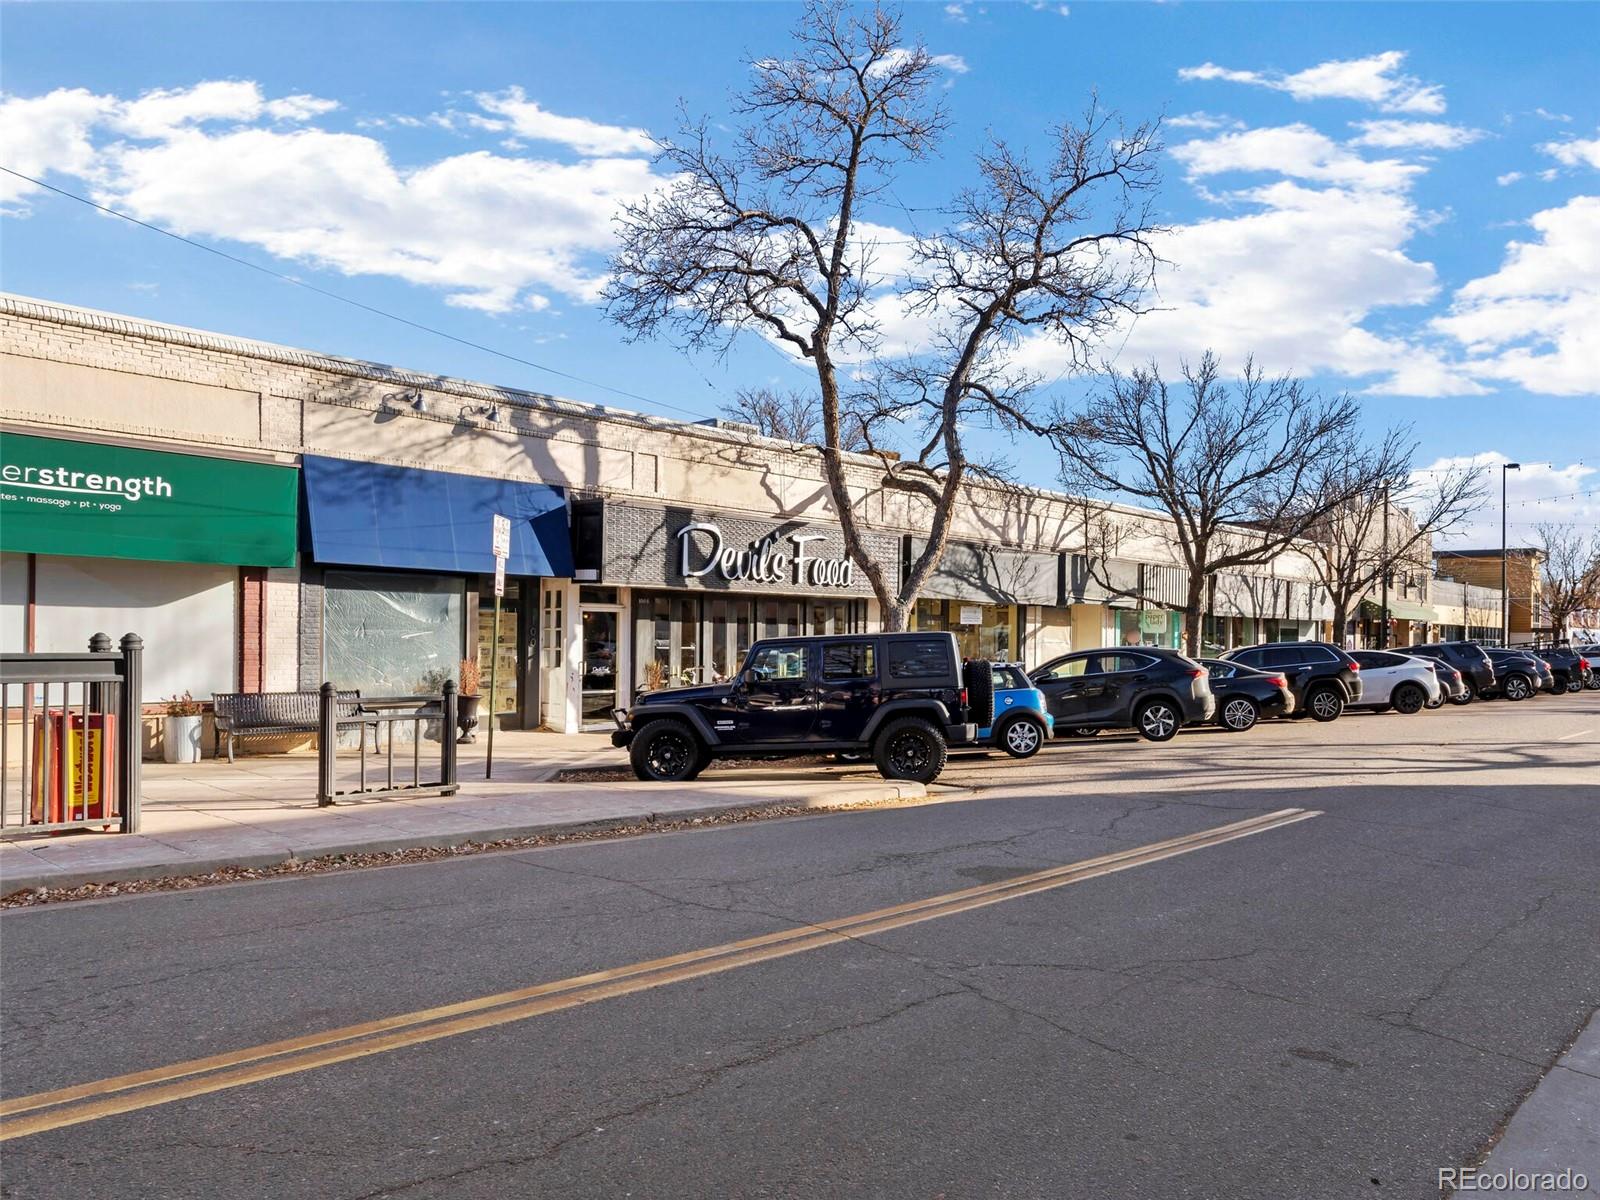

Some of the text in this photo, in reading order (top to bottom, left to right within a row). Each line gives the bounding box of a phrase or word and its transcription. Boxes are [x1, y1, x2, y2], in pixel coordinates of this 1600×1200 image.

[26, 496, 71, 508] massage
[99, 503, 122, 512] yoga
[677, 522, 856, 587] Devil's Food
